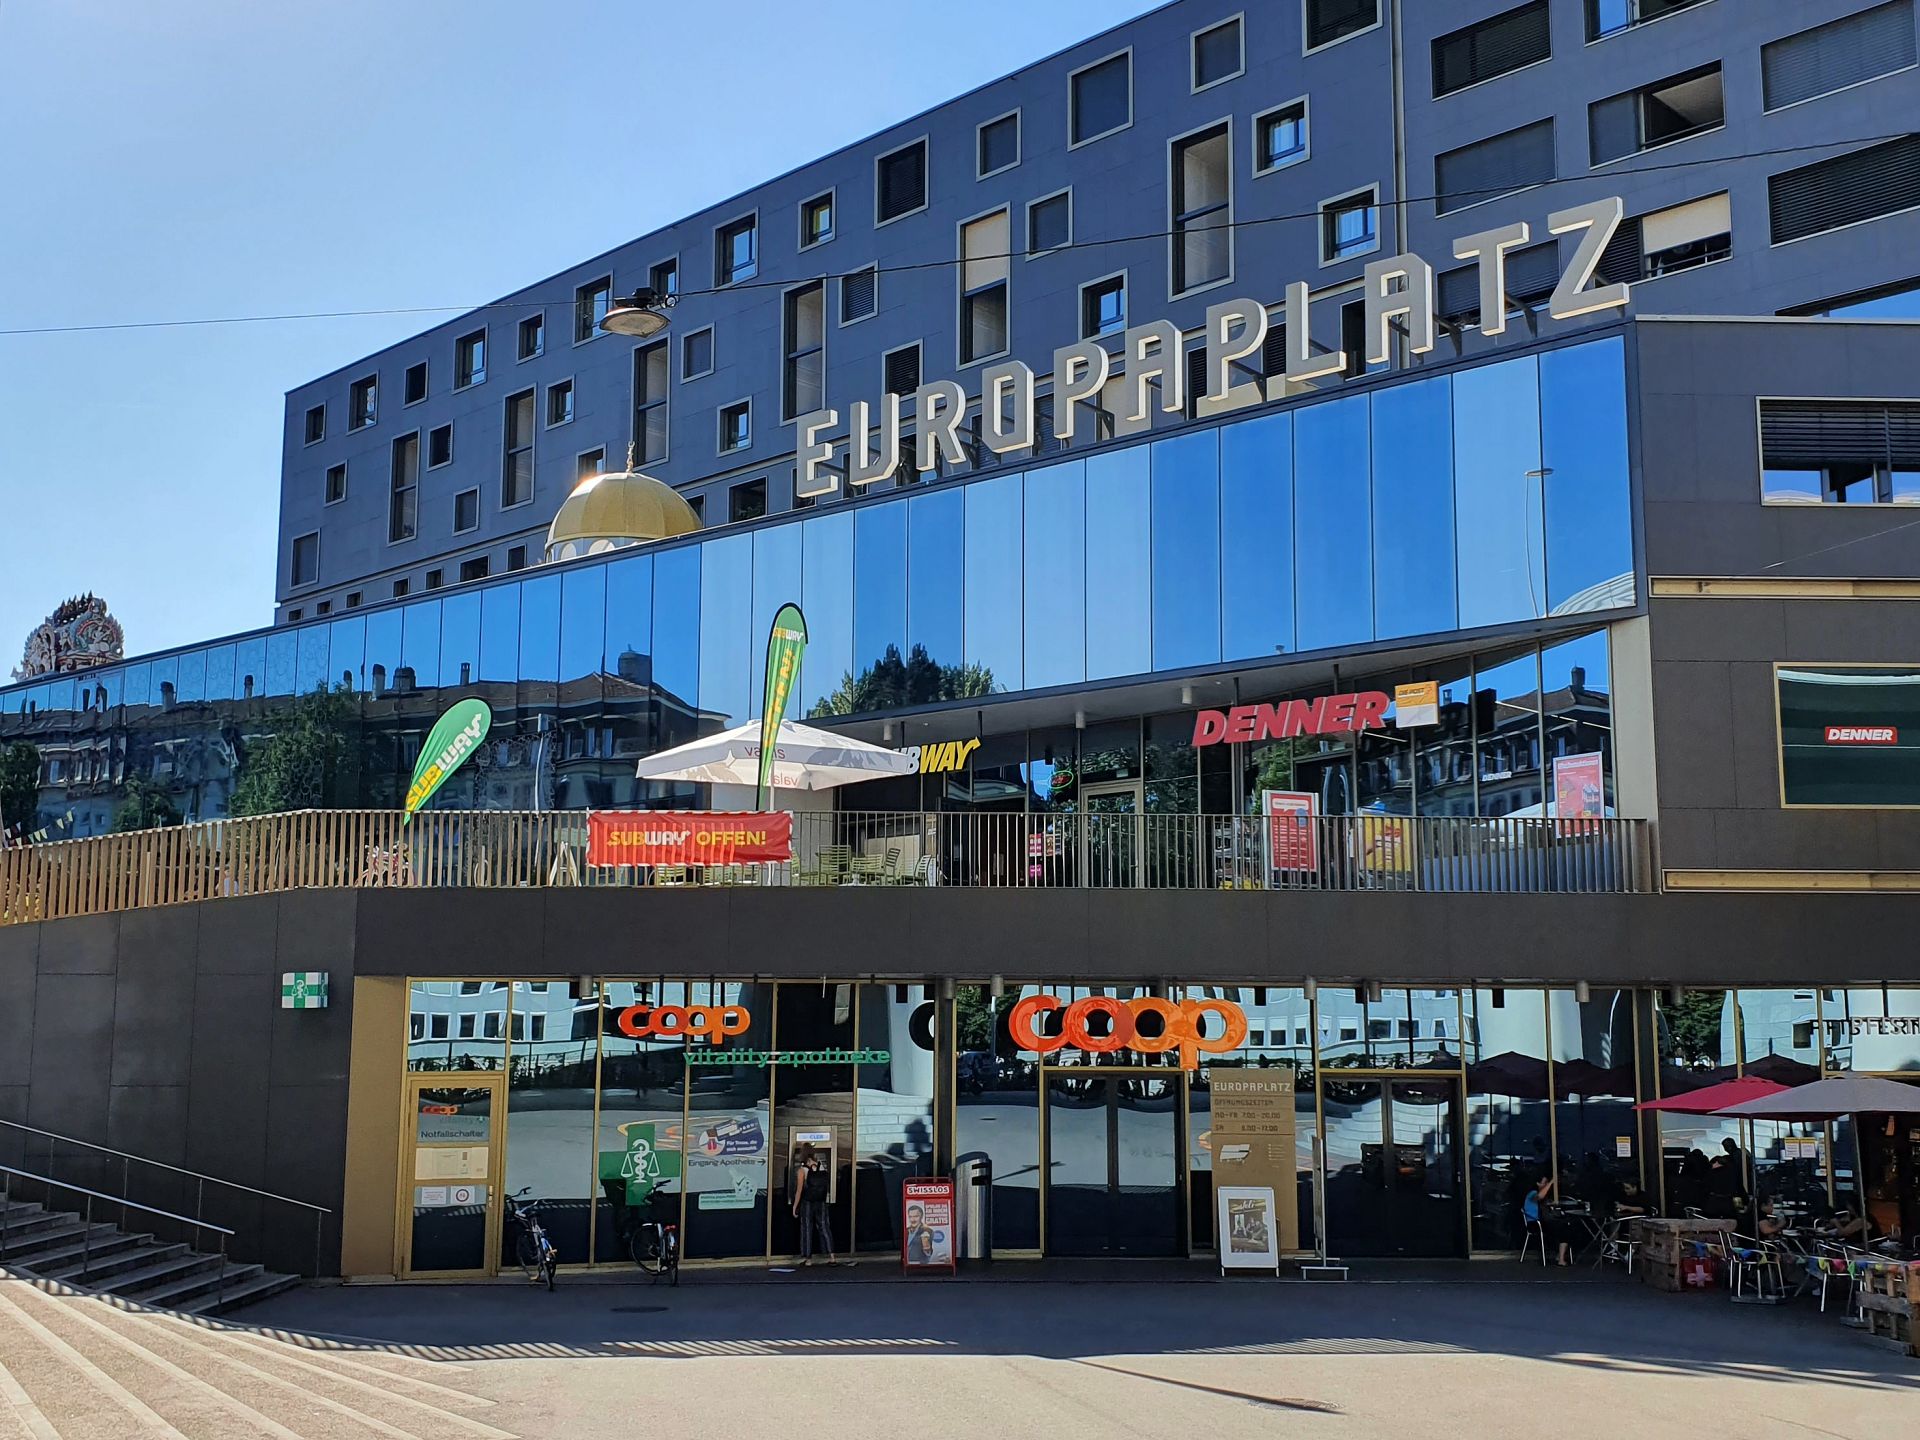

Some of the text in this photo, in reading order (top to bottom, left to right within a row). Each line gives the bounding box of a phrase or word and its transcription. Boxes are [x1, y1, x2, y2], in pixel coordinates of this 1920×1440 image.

[796, 196, 1630, 499] EUROPAPLATZ
[773, 627, 804, 642] SUBWAY
[1191, 690, 1390, 747] DENNER
[1828, 728, 1893, 741] DENNER
[744, 746, 786, 759] vais
[893, 737, 981, 775] BWAY
[405, 713, 482, 812] SUBWAY
[607, 829, 767, 847] SUBWAY OFFEN!
[618, 1004, 750, 1044] coop
[1008, 995, 1247, 1071] coop
[683, 1047, 891, 1068] vitality apotheke
[1214, 1081, 1291, 1092] EUROPAPLATZ
[422, 1104, 458, 1116] coop
[421, 1129, 485, 1138] Notfallschalter
[908, 1186, 948, 1194] SWISSLOS
